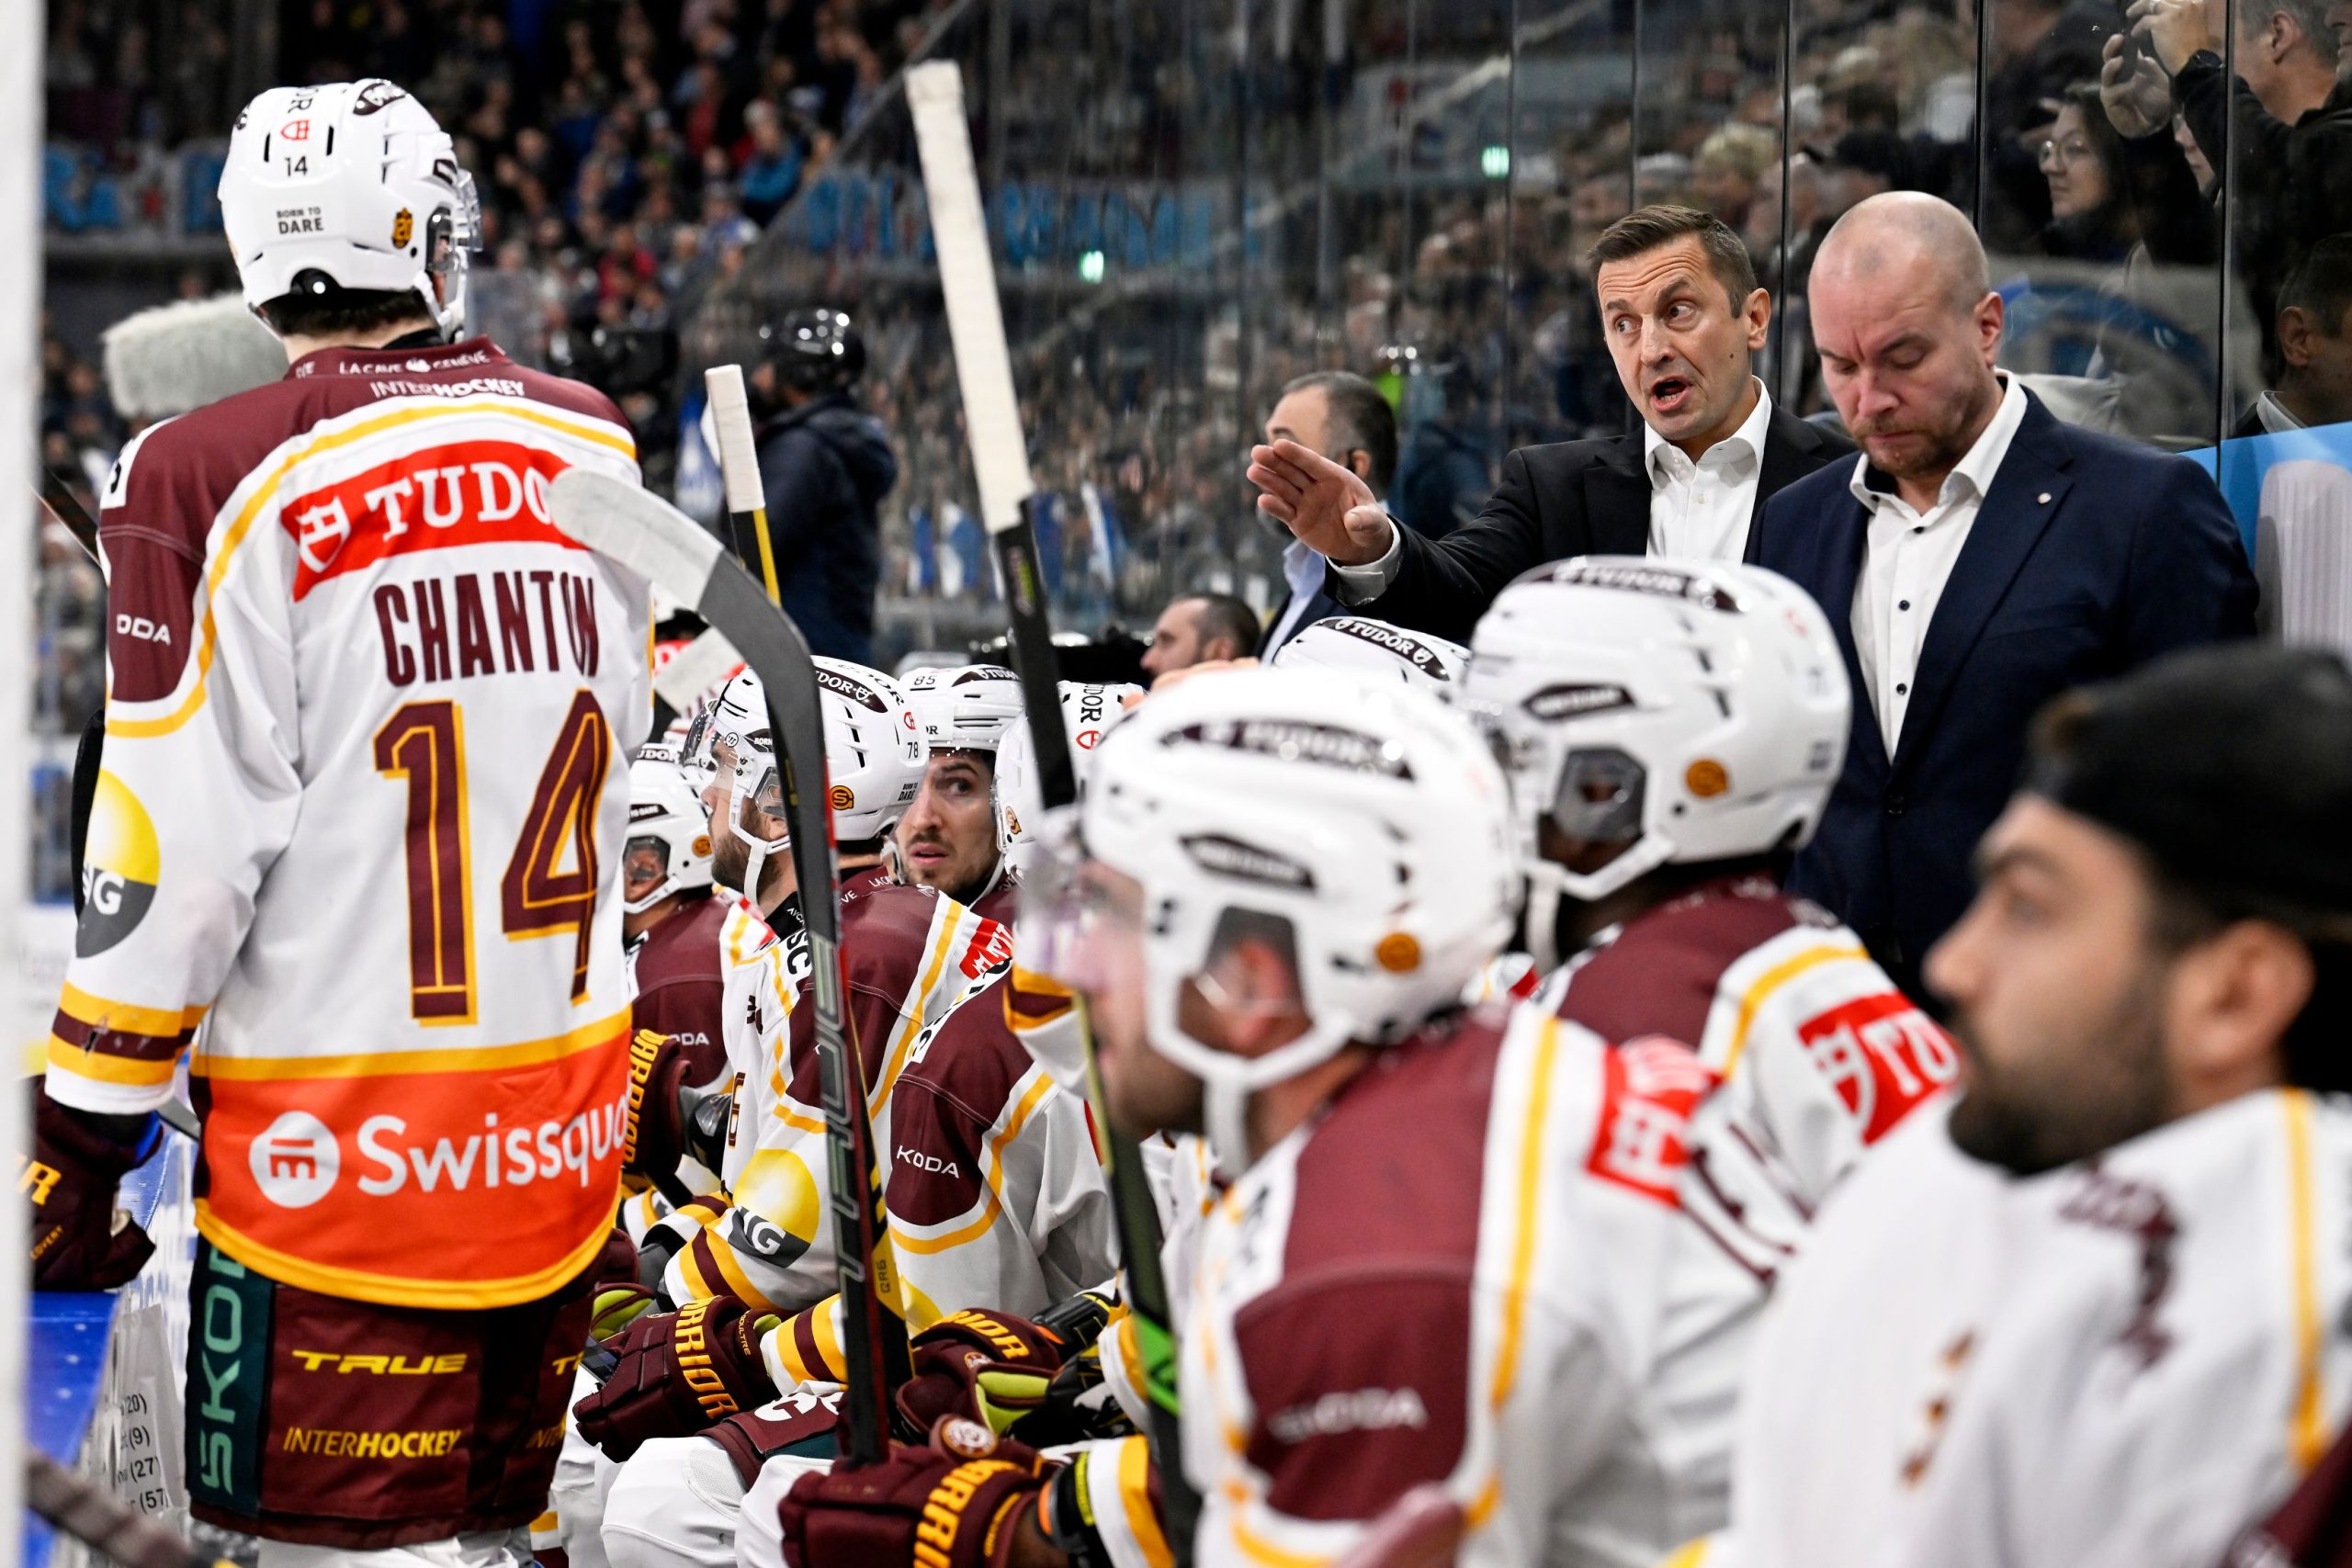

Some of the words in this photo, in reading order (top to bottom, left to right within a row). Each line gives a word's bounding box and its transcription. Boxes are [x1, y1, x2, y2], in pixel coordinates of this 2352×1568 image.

[284, 156, 308, 176] 14
[277, 209, 304, 219] BORN
[308, 207, 321, 216] TO
[278, 218, 324, 234] DARE
[370, 378, 526, 398] INTERHOCKEY
[365, 461, 555, 541] TUDO
[1349, 622, 1415, 655] TUDOR
[815, 670, 854, 694] DOR
[913, 675, 936, 686] 85
[907, 741, 919, 760] 78
[373, 686, 613, 1028] 14
[356, 1089, 632, 1197] Swissquo
[896, 1145, 960, 1179] KODA
[291, 1348, 468, 1375] TRUE
[129, 1425, 151, 1450] (9)
[283, 1427, 462, 1459] INTERHOCKEY
